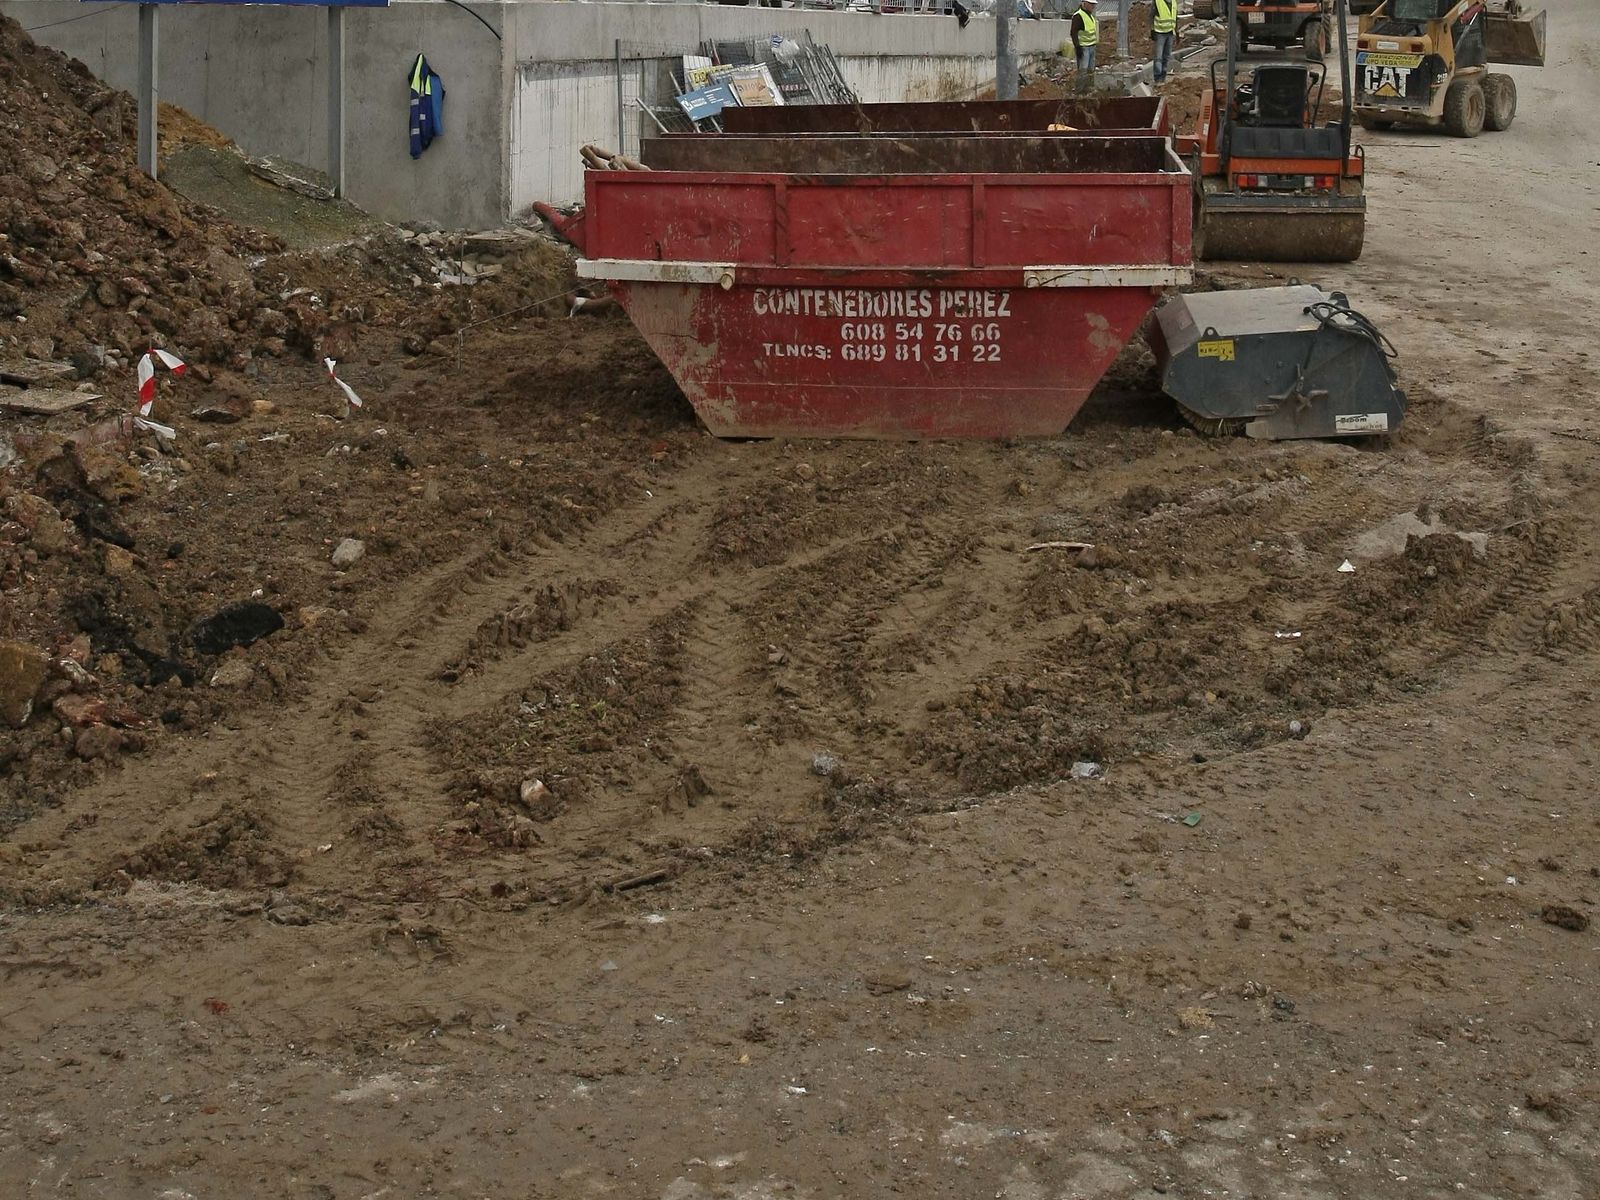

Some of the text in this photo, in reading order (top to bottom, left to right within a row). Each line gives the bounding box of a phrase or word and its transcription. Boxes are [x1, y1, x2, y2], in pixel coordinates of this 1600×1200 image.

[1364, 65, 1411, 98] CAT
[753, 288, 1012, 318] CONTENEDORES PEREZ
[840, 322, 1001, 342] 608 54 76 66
[840, 343, 887, 362] 689
[895, 343, 922, 362] 81
[932, 343, 960, 362] 31
[972, 343, 1001, 362] 22
